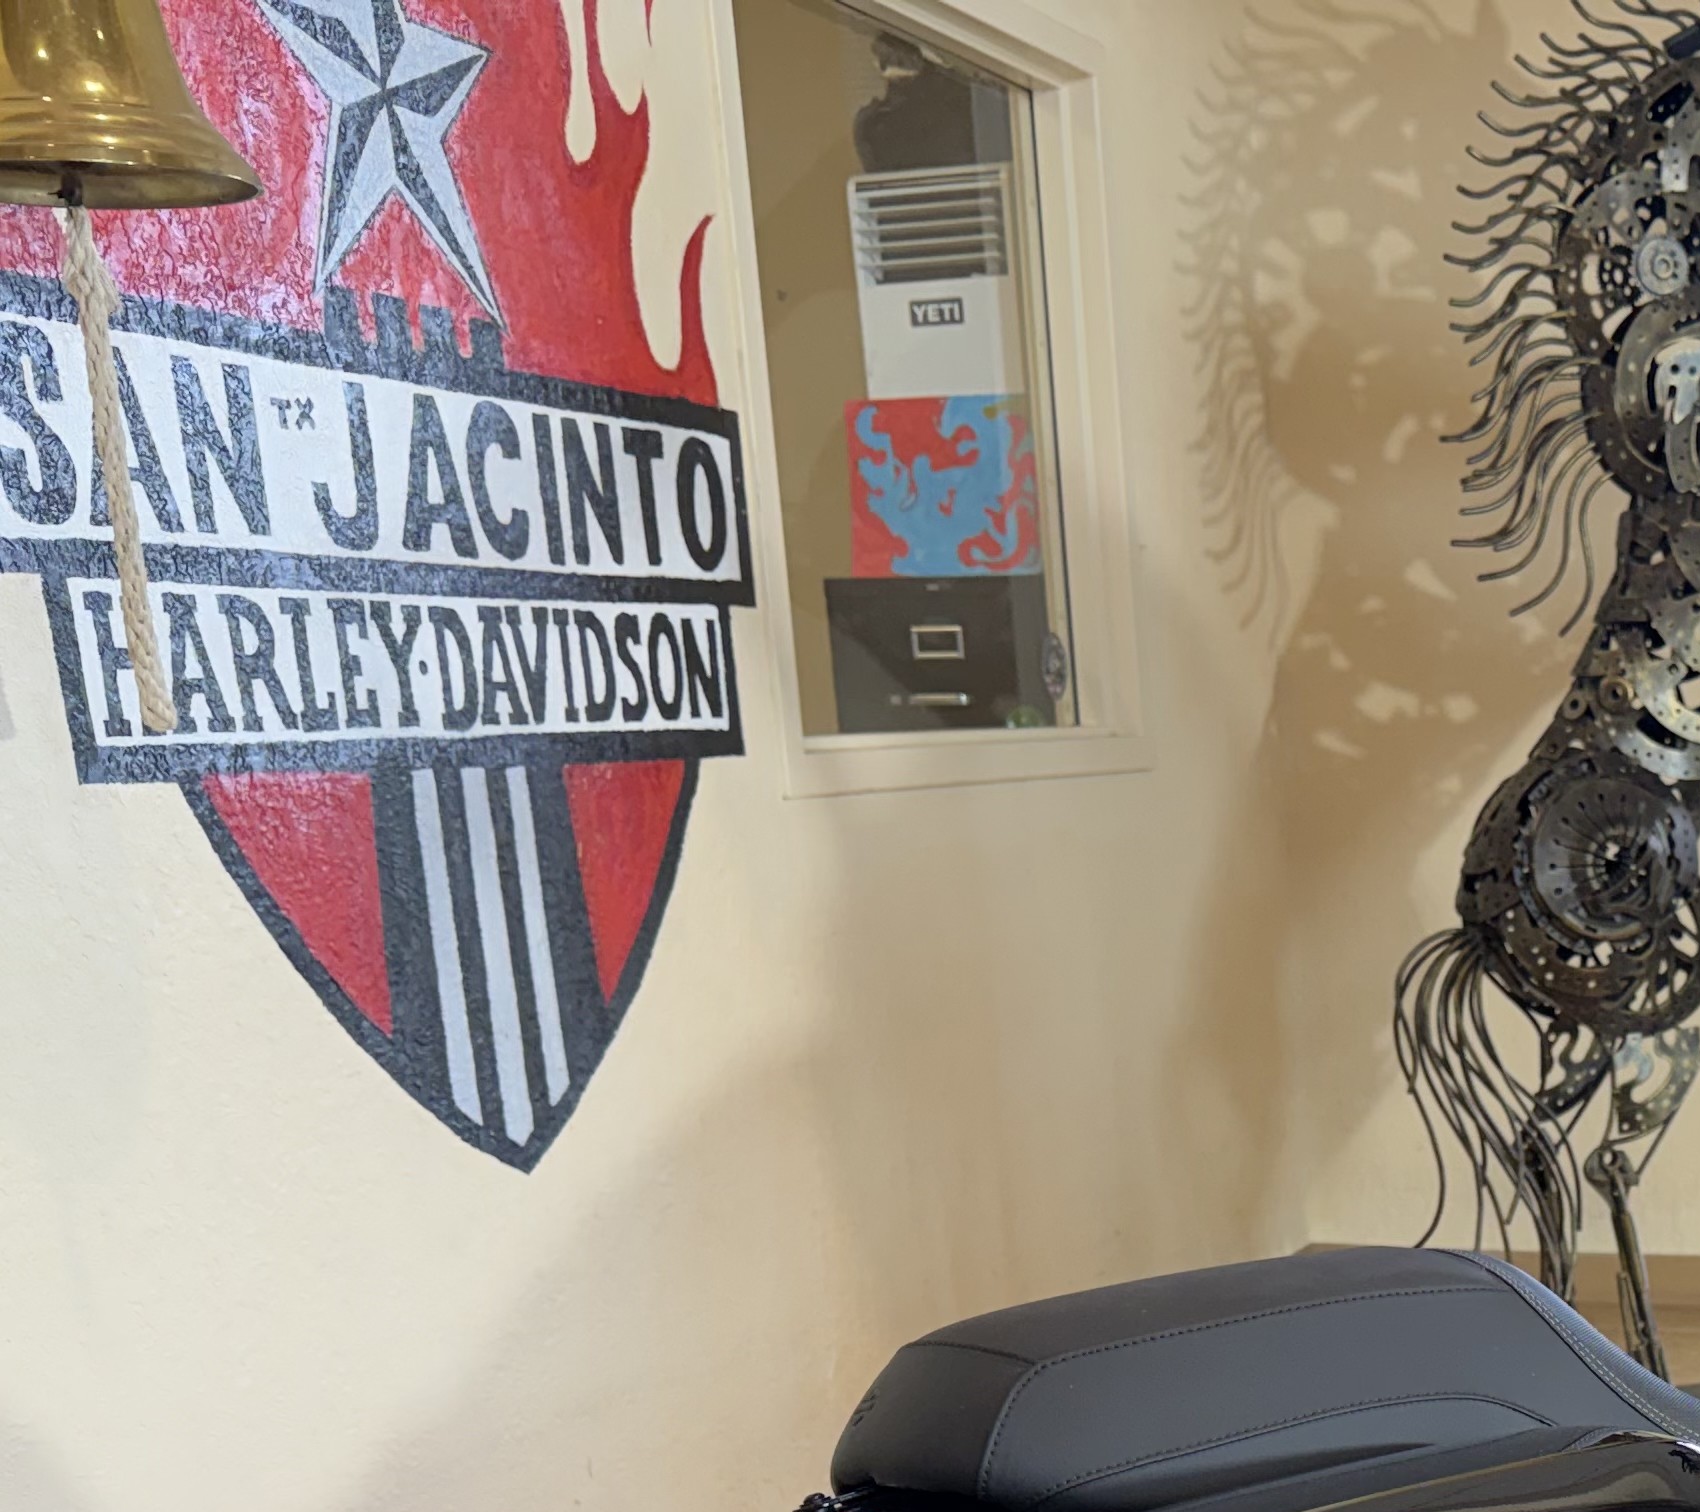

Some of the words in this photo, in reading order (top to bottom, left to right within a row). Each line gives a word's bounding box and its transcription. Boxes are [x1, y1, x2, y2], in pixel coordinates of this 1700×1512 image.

[912, 301, 960, 323] YETI
[0, 320, 271, 536] SAN
[312, 381, 728, 572] JACINTO
